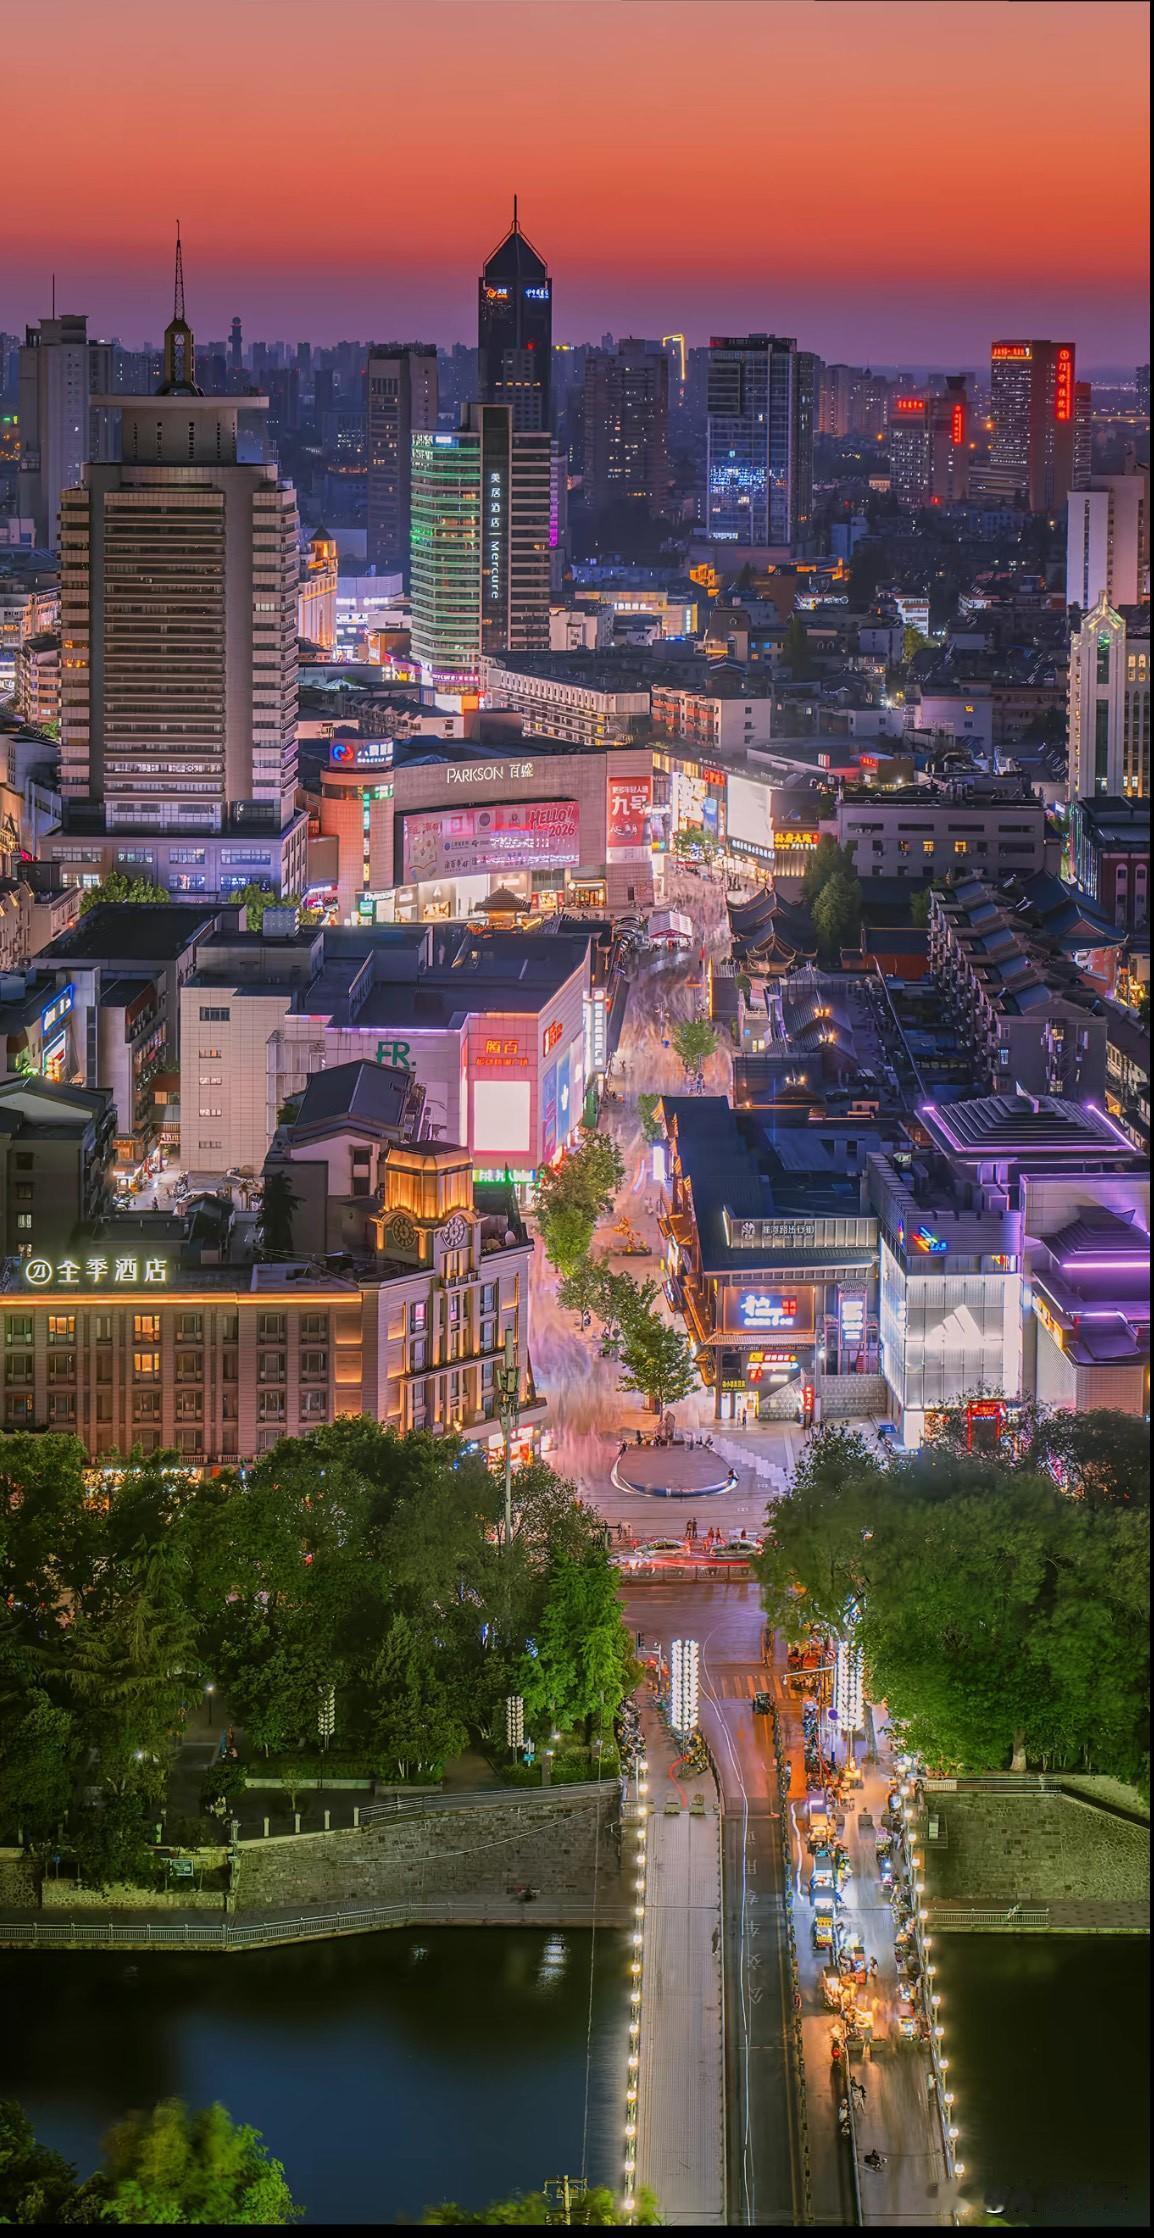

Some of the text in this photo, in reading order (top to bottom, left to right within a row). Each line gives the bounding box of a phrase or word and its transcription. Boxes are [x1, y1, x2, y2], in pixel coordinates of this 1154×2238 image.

[490, 472, 501, 599] 美居酒店 Mercure
[447, 762, 534, 784] PARKSON 百盛
[611, 795, 647, 816] 九号
[549, 823, 576, 838] 2026
[57, 1258, 168, 1283] 全季酒店
